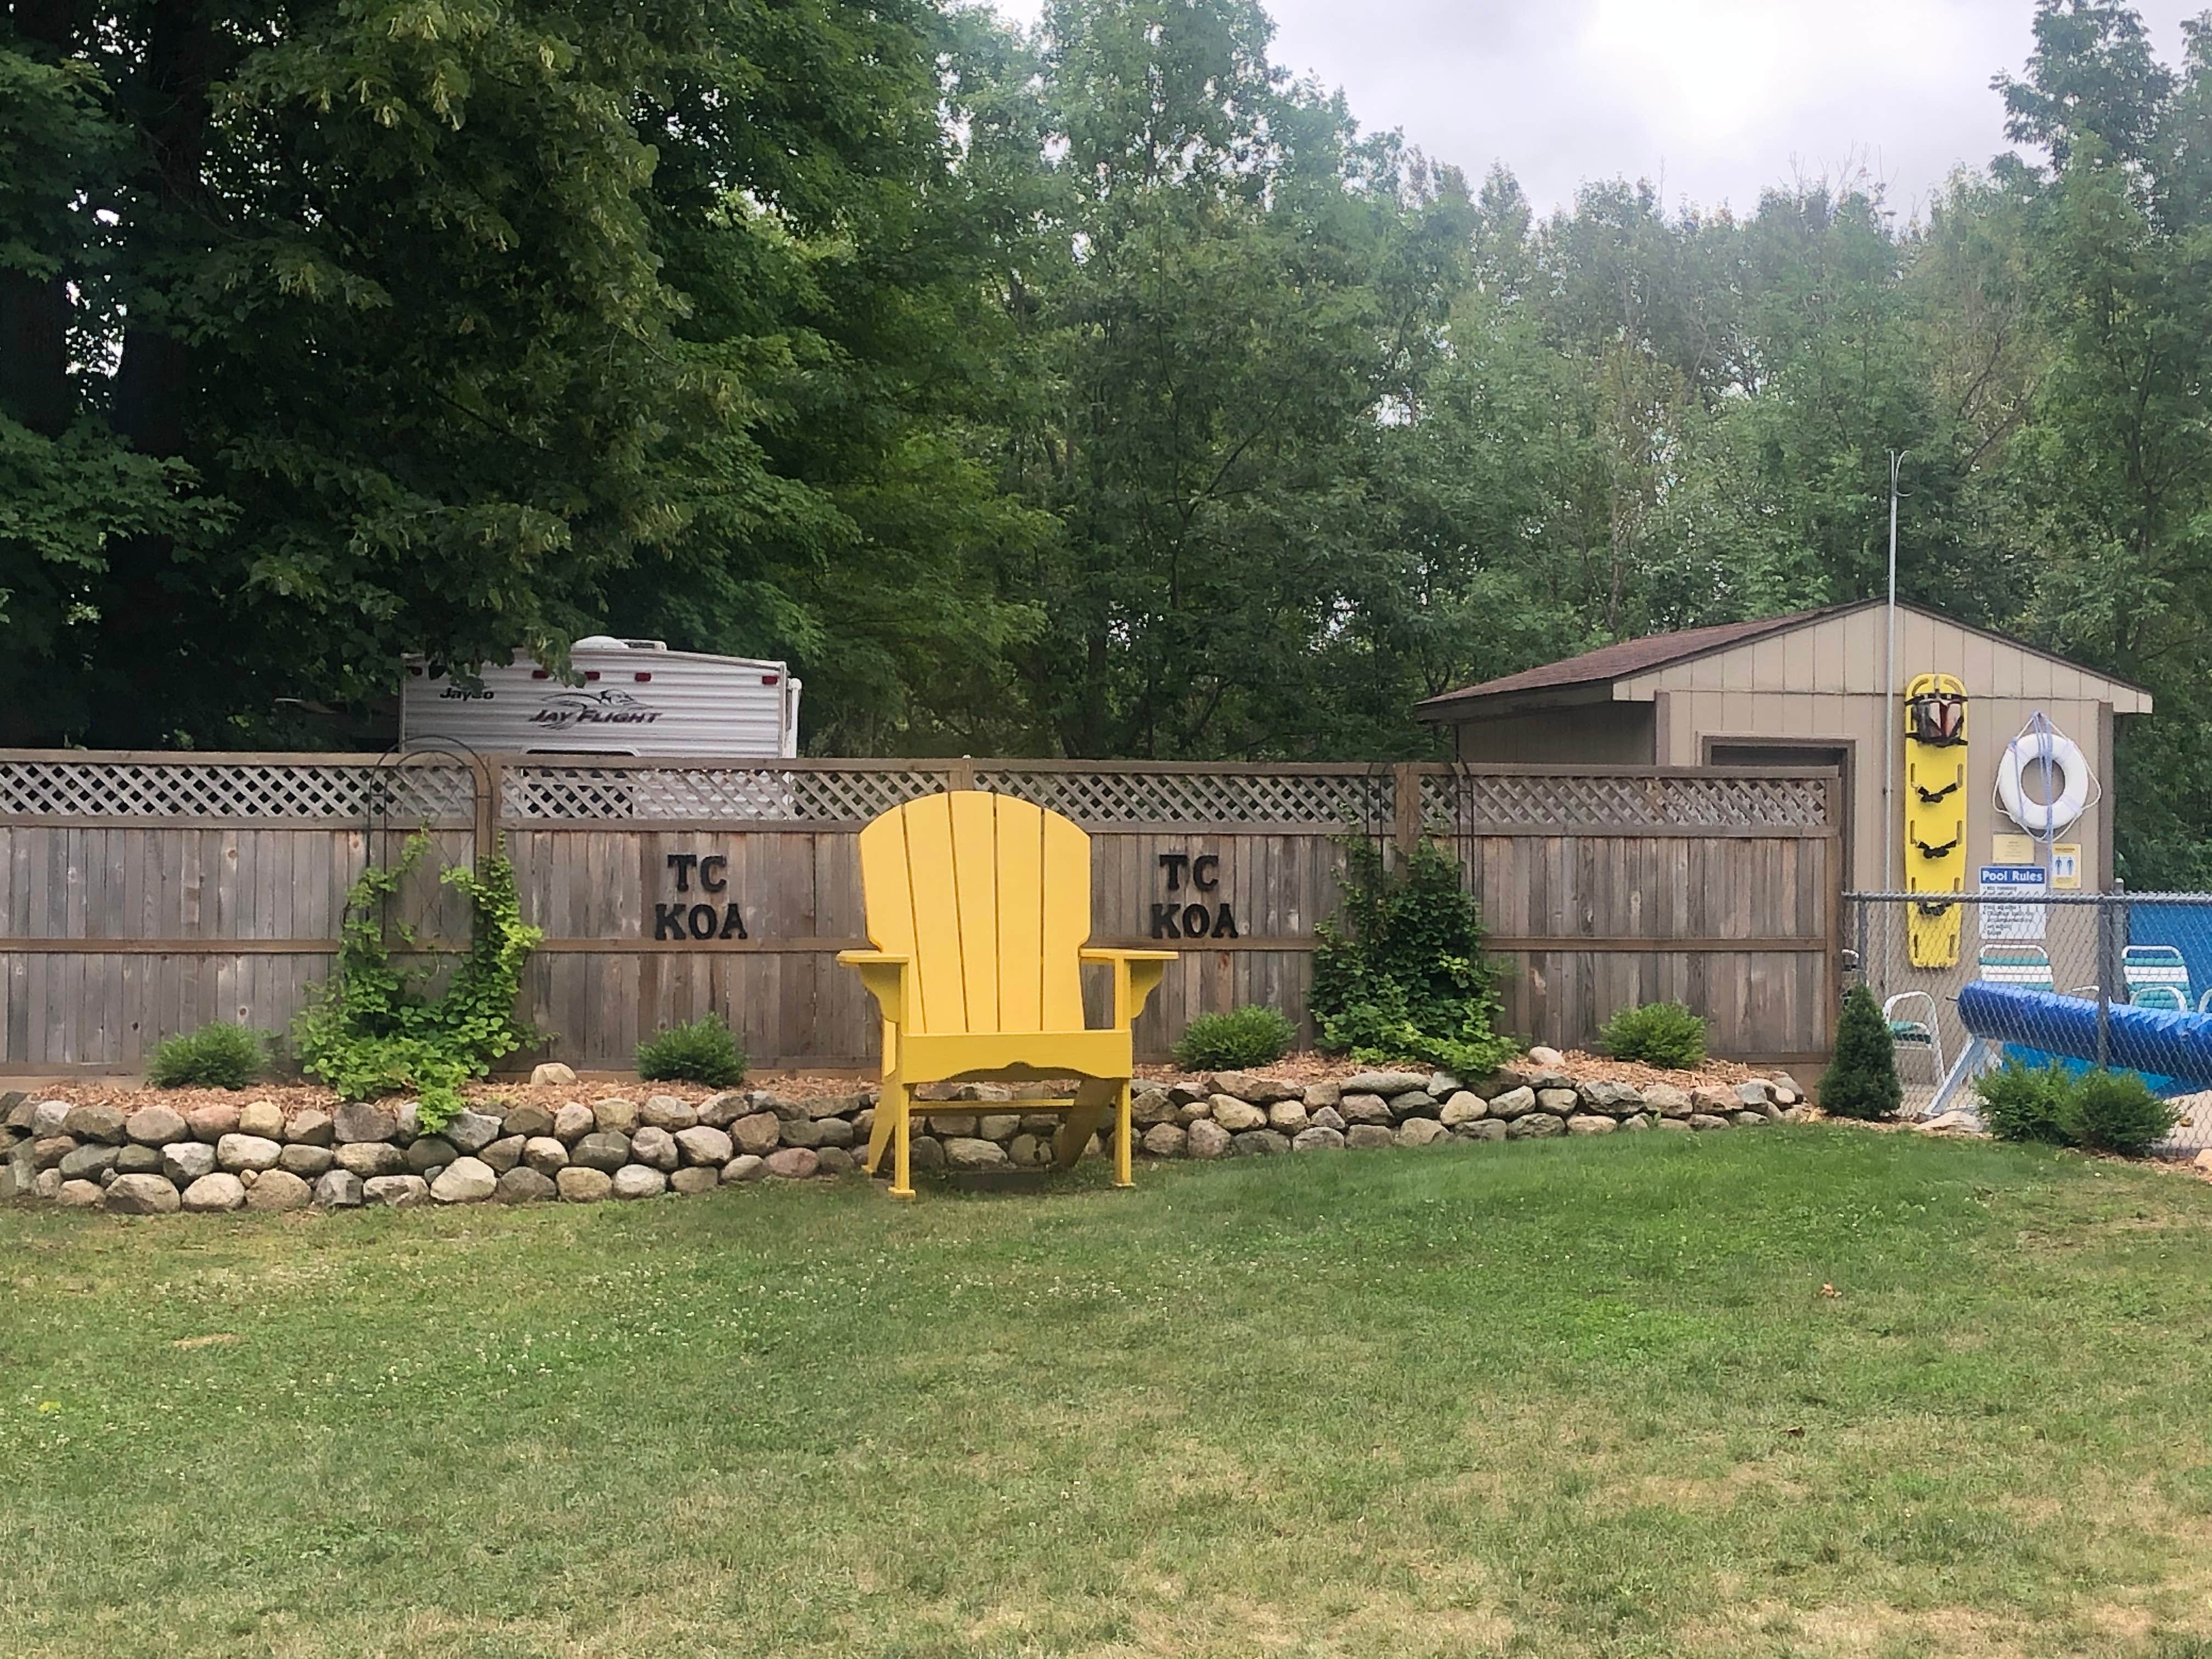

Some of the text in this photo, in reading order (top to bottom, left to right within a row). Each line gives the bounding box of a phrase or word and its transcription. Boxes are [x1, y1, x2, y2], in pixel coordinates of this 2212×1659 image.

[528, 709, 662, 723] JAY FLIGHT
[667, 854, 727, 893] TC
[1159, 854, 1218, 891] TC
[1982, 870, 2007, 881] Pool
[2012, 870, 2043, 882] Rules
[655, 903, 748, 940] KOA
[1152, 903, 1238, 939] KOA
